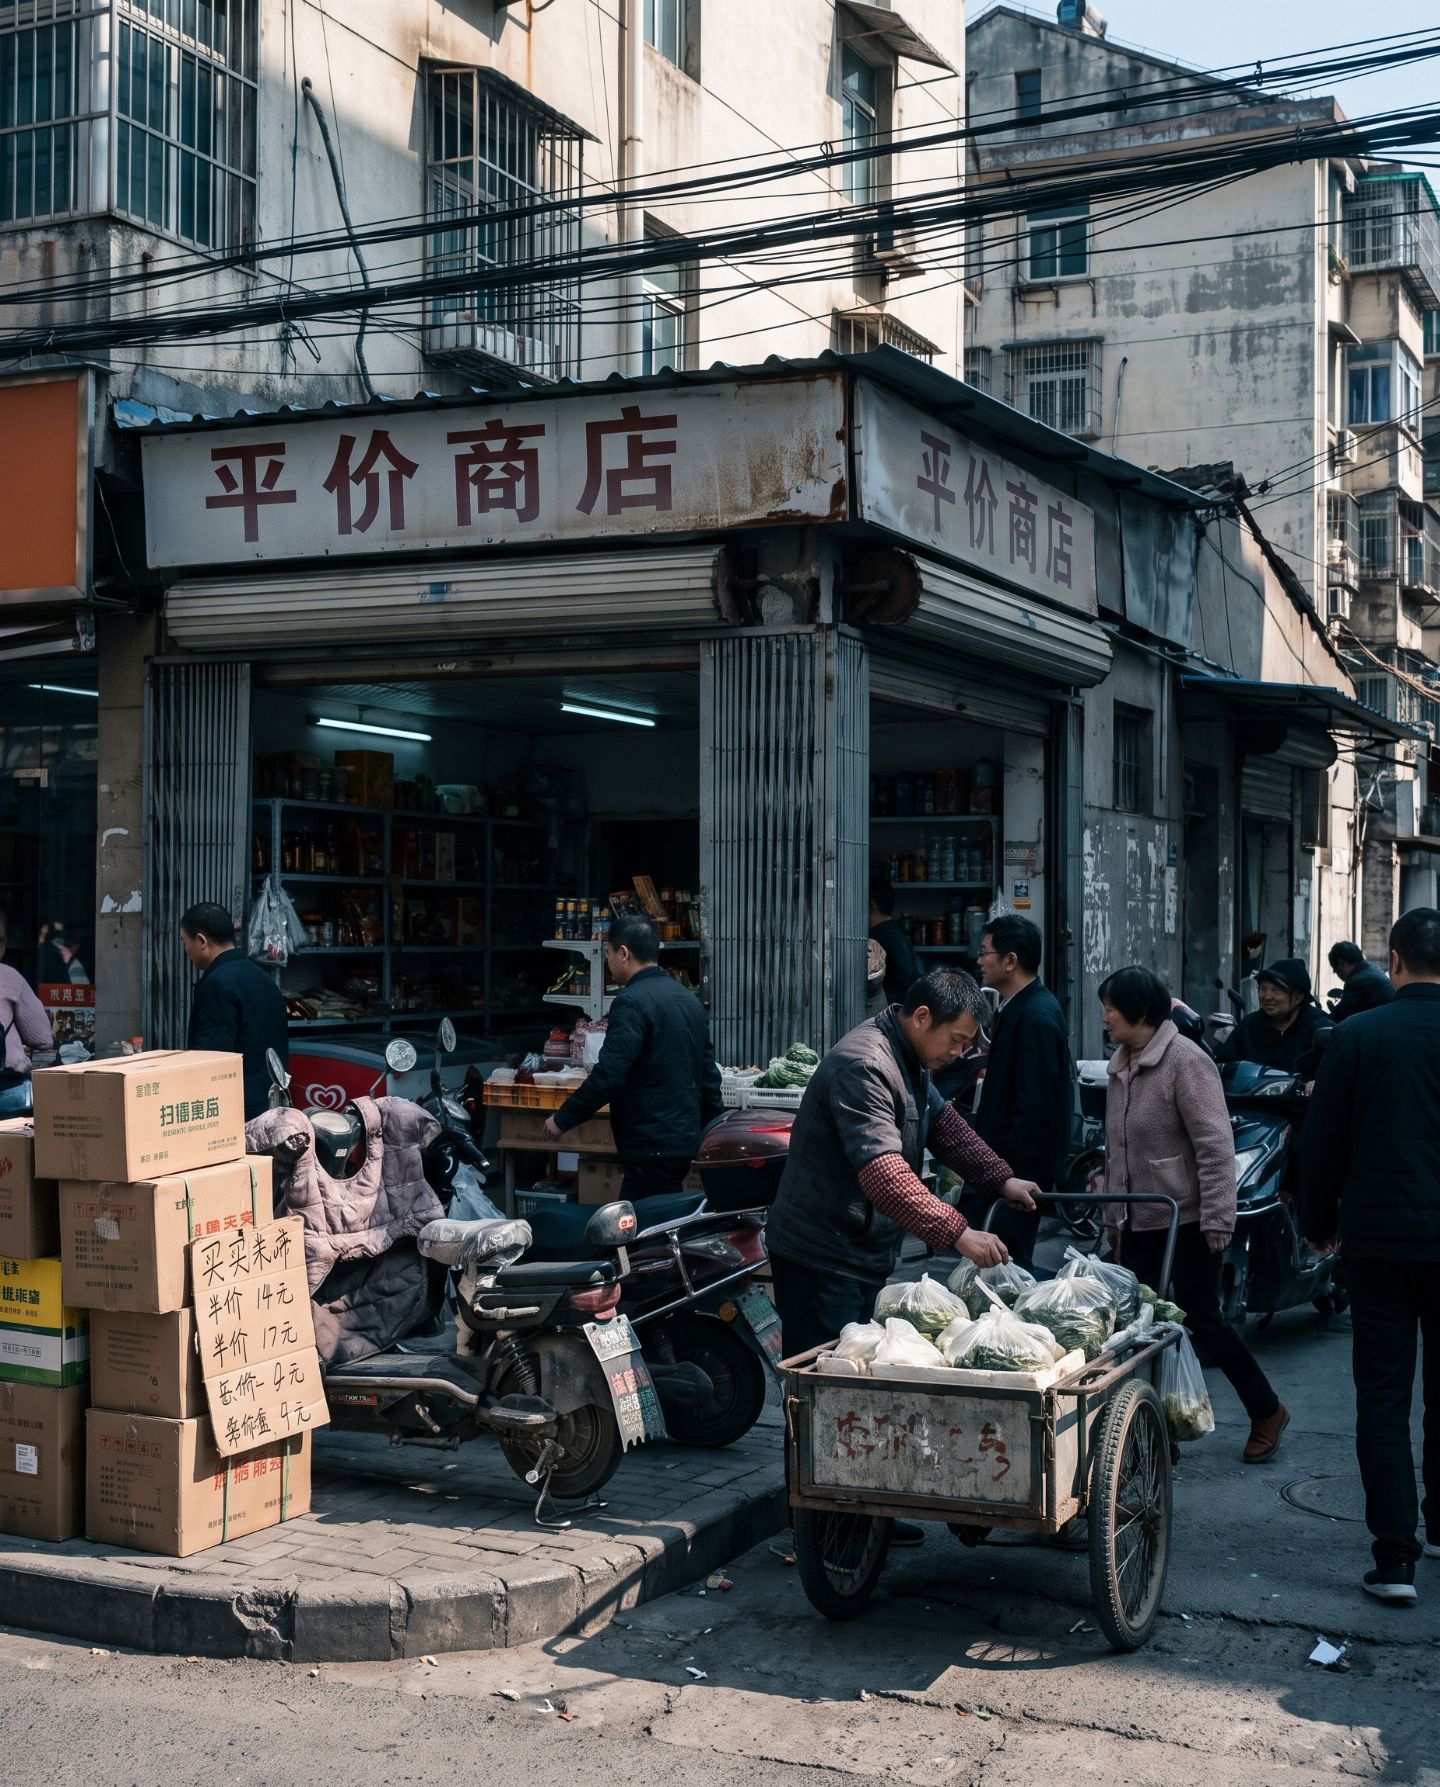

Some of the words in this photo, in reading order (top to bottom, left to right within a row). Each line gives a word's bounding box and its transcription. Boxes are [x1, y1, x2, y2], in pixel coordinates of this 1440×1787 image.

[205, 405, 678, 543] 平价商店
[917, 430, 1073, 589] 平价商店
[208, 1286, 243, 1325] 半价
[257, 1282, 294, 1310] 14元
[212, 1328, 248, 1368] 半价
[262, 1321, 298, 1350] 17元
